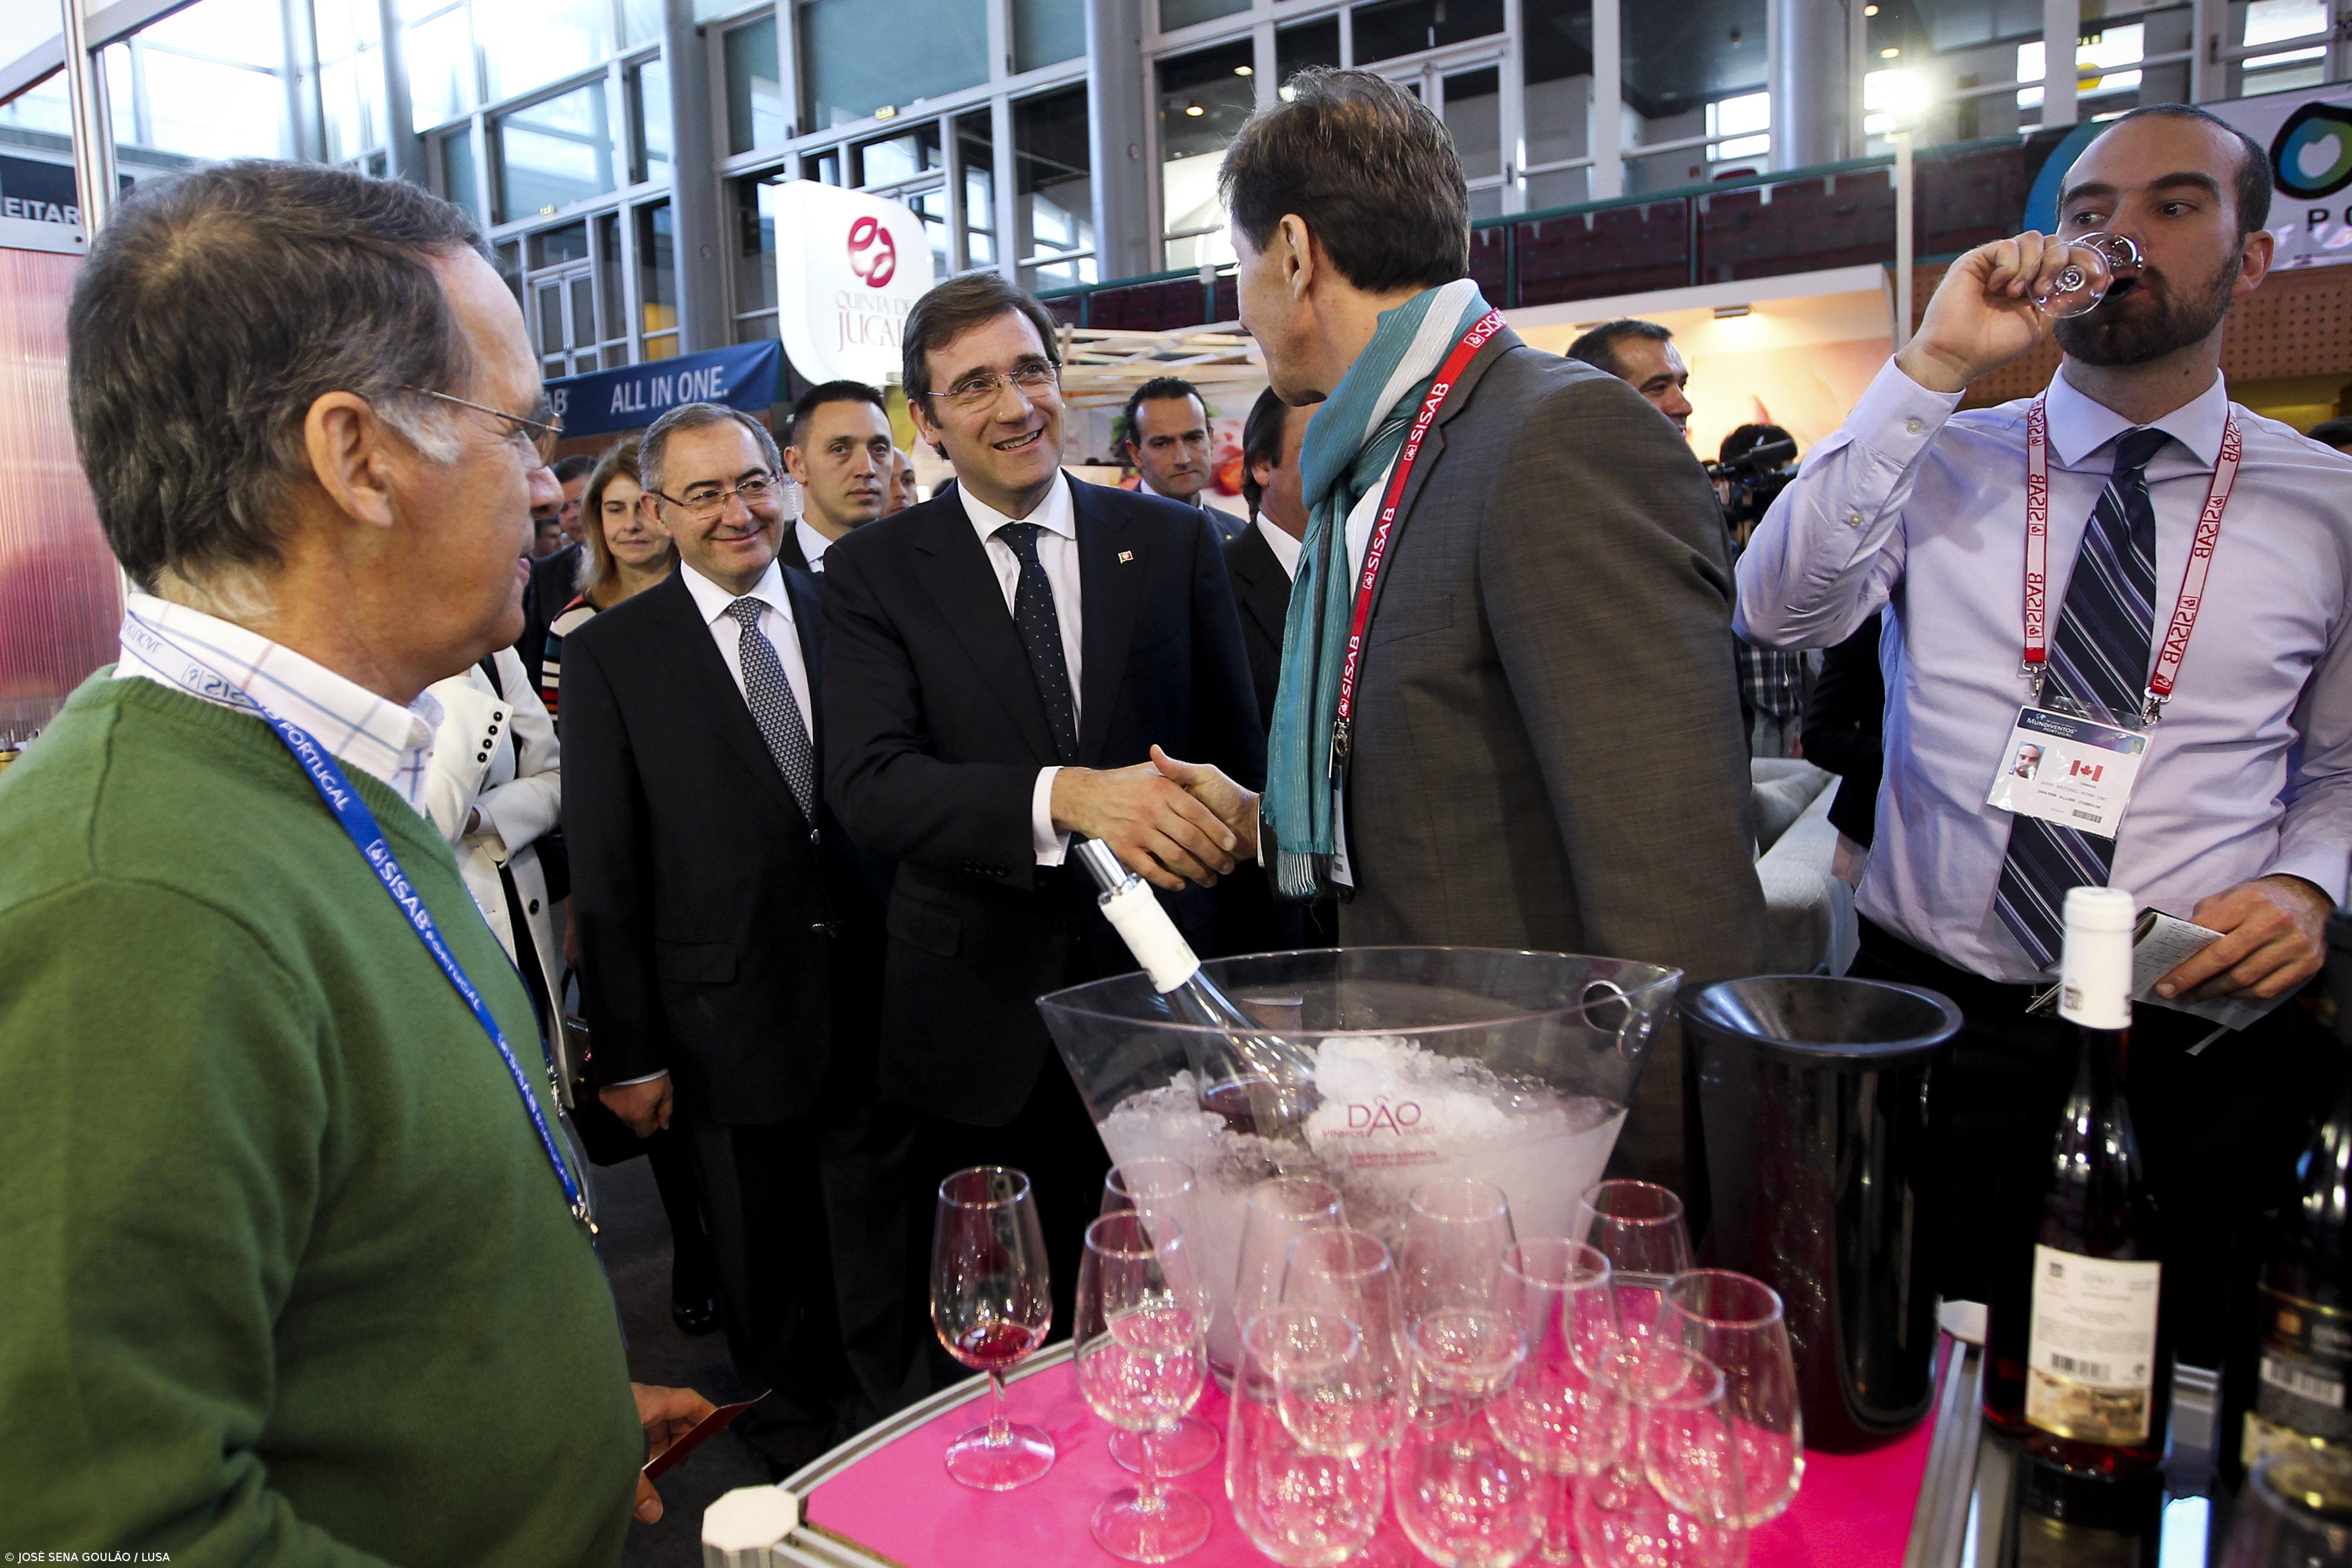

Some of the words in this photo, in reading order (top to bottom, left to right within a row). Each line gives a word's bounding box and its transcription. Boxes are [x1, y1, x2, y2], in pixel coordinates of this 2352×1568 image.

[836, 290, 891, 313] QUINTA
[610, 379, 646, 415] ALL
[651, 374, 673, 407] IN
[677, 365, 729, 402] ONE.
[1411, 382, 1449, 442] SISAB
[1368, 507, 1395, 571] SISAB
[1342, 635, 1359, 698] SISAB
[2043, 727, 2072, 737] PORTUGAL
[279, 722, 350, 811] PORTUGAL
[379, 861, 430, 930] SISAB
[1348, 1094, 1422, 1138] DÃO
